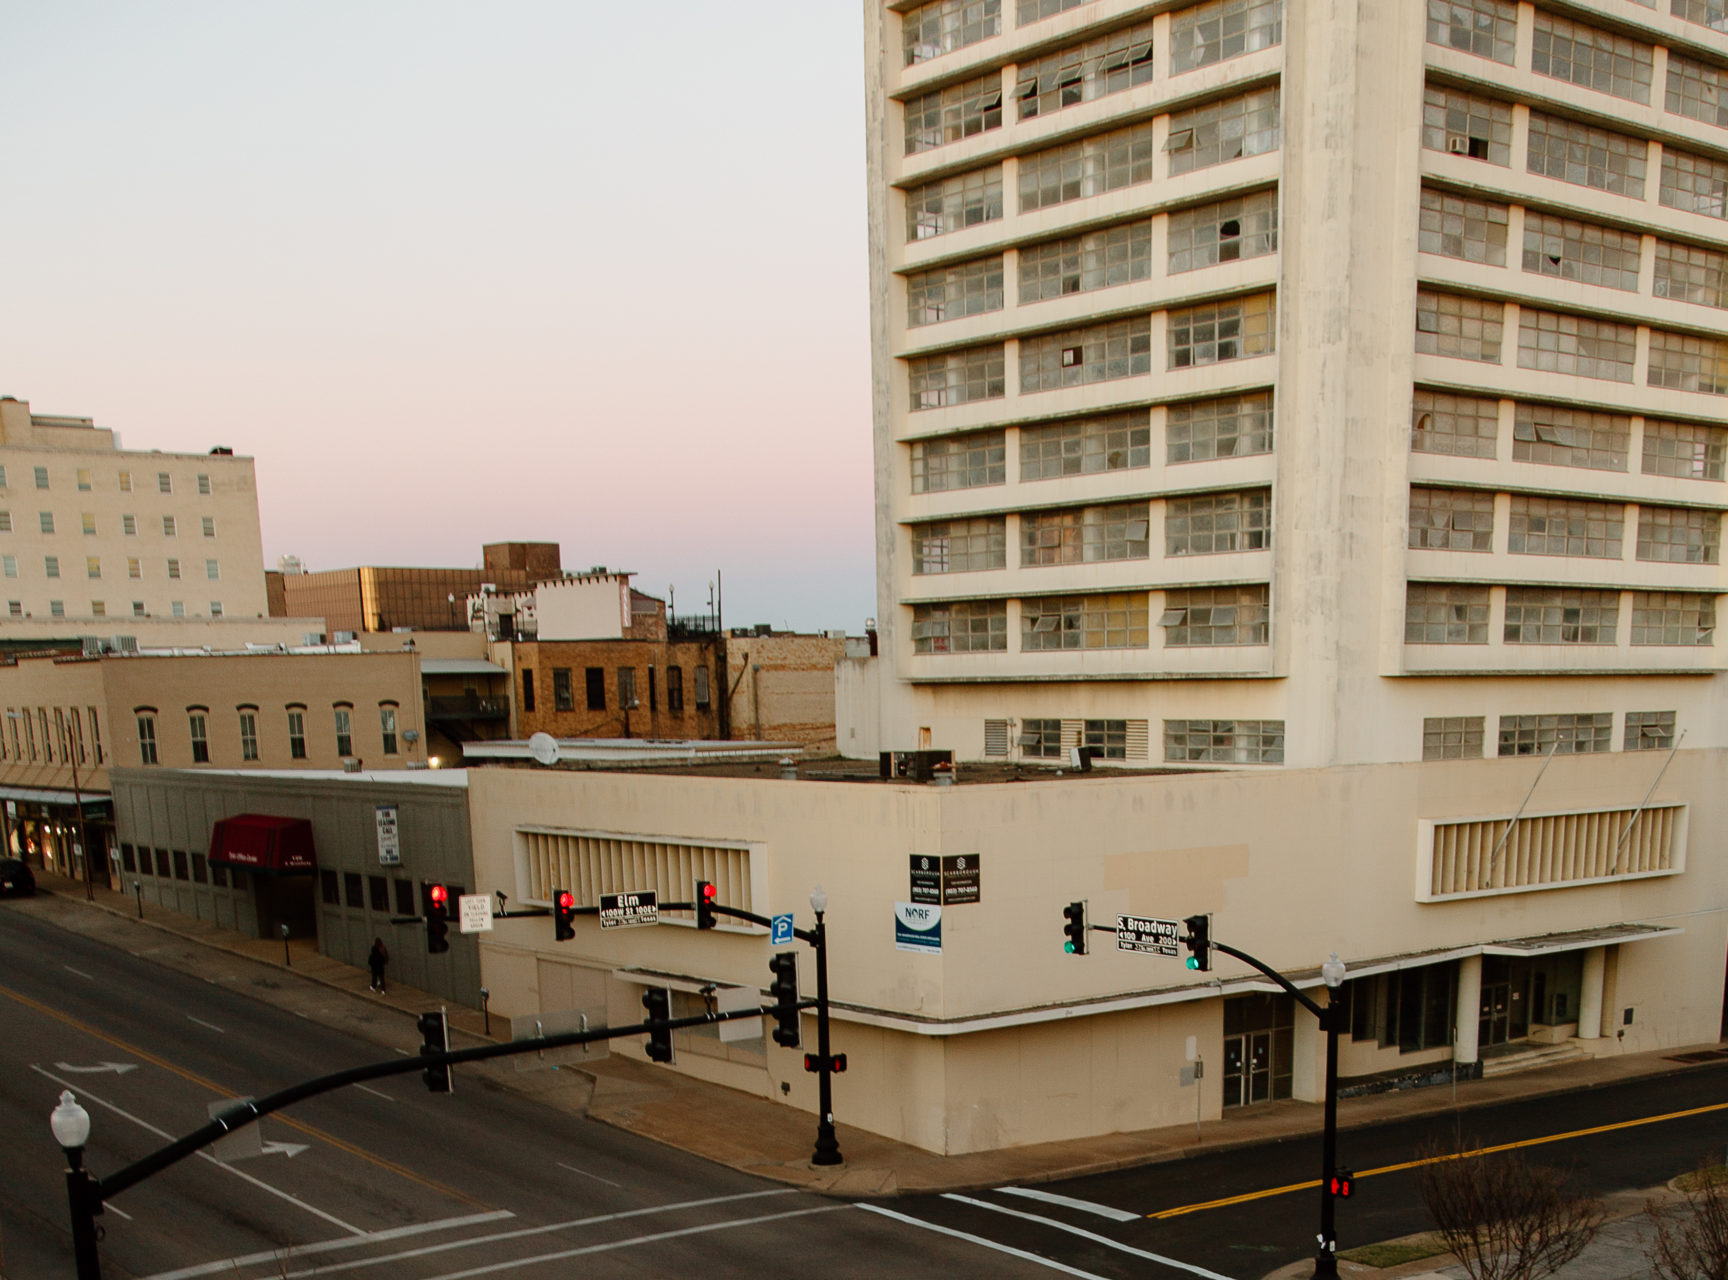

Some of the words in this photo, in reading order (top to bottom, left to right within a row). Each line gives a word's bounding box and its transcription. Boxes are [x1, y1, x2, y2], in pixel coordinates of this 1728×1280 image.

[617, 893, 640, 908] Elm
[606, 908, 624, 917] 100W
[625, 907, 634, 915] St
[635, 905, 651, 914] 100E
[778, 922, 788, 936] P
[1118, 917, 1126, 930] S.
[1128, 918, 1177, 938] Broadway
[1124, 931, 1136, 940] 100
[1141, 934, 1154, 943] Ave
[1159, 936, 1172, 945] 200
